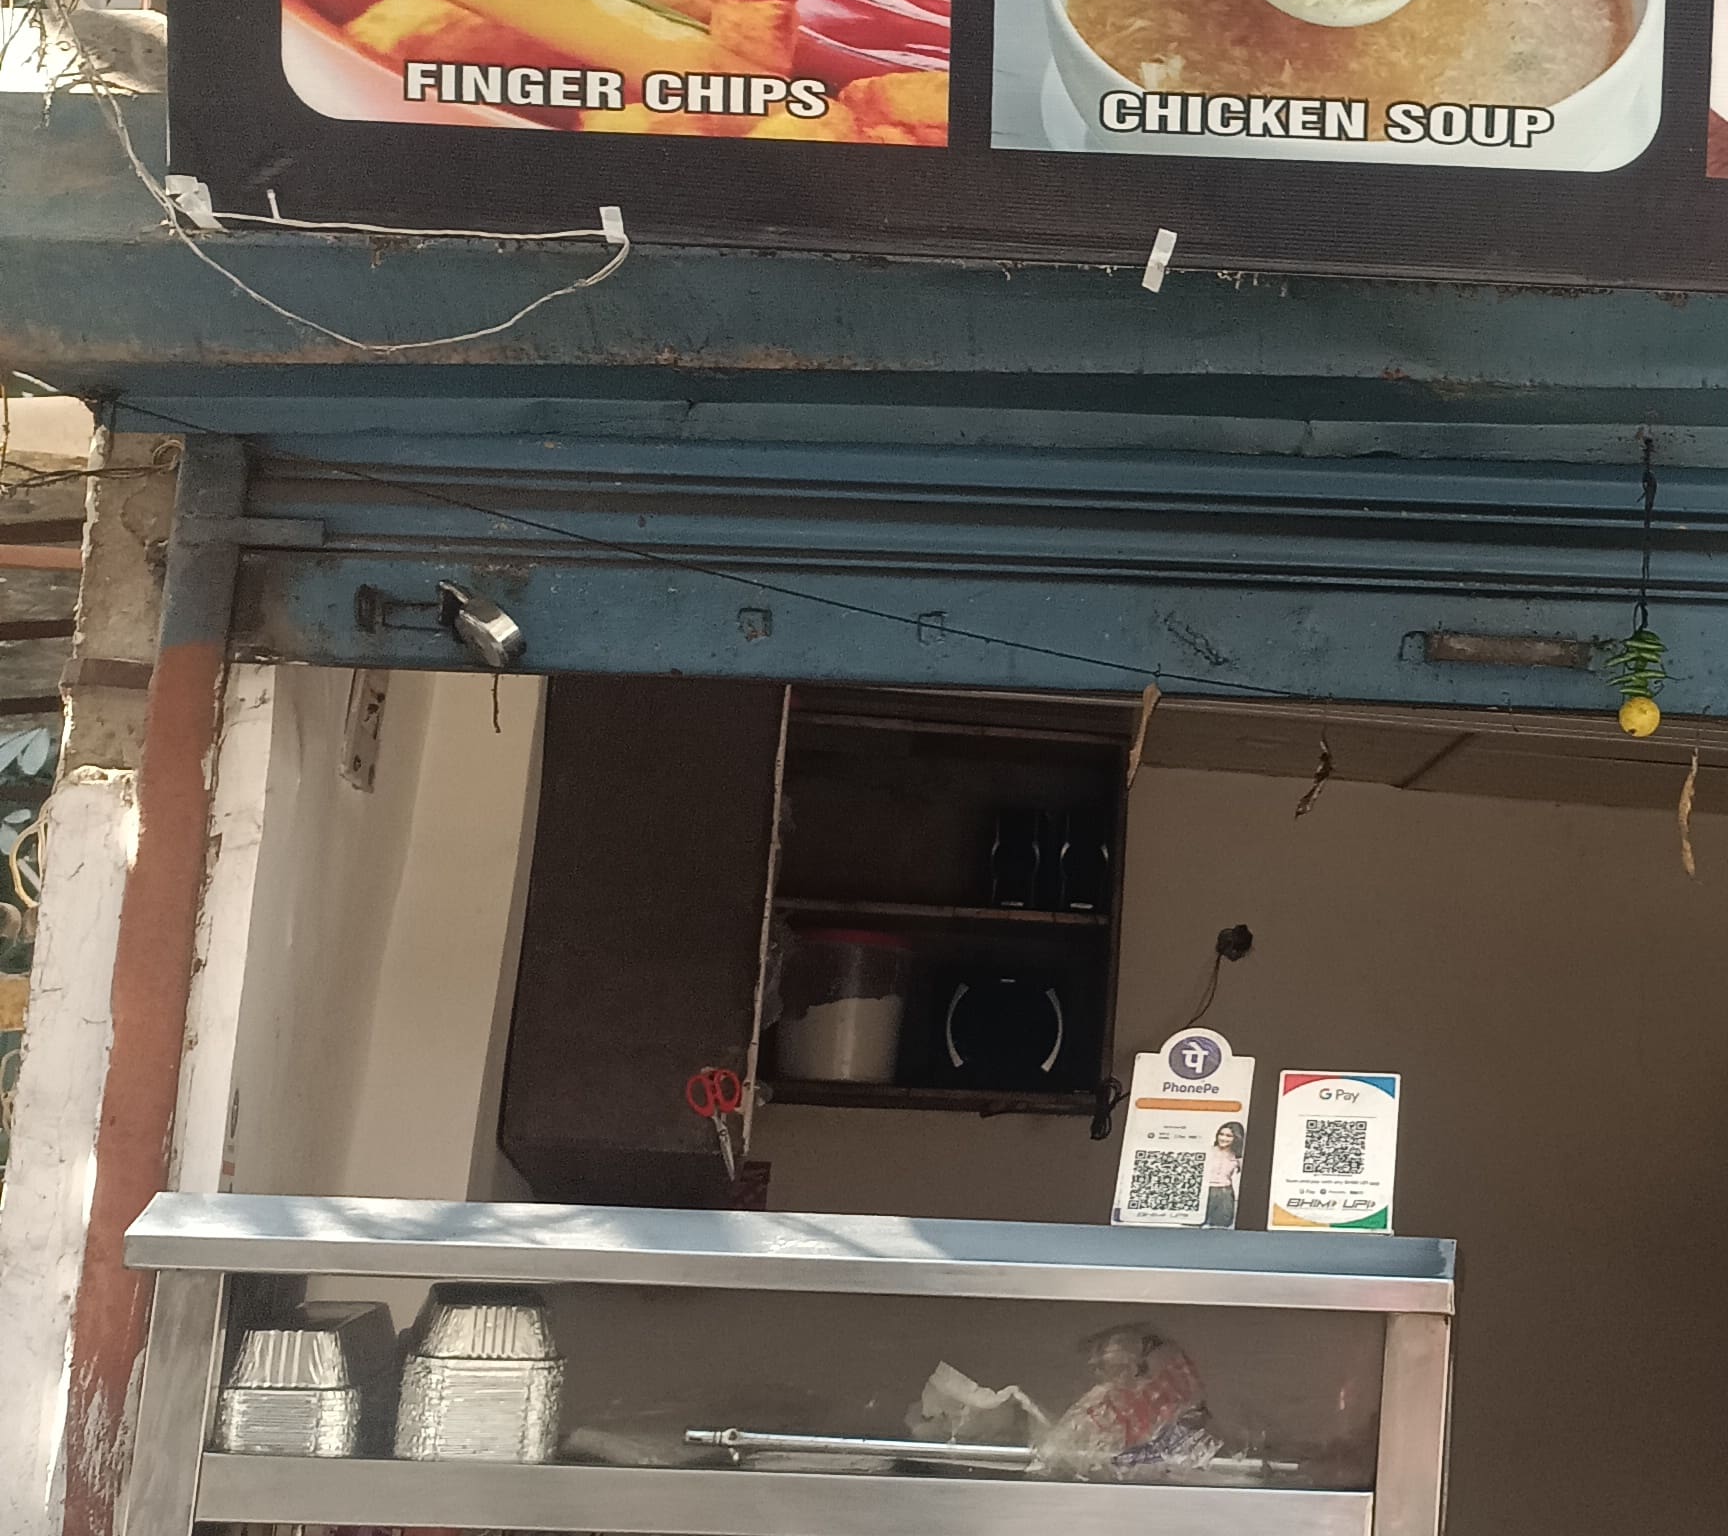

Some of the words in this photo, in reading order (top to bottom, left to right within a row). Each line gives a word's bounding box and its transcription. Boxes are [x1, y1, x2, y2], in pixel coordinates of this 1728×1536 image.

[404, 61, 624, 113] FINGER
[643, 68, 830, 120] CHIPS
[1100, 89, 1370, 141] CHICKEN
[1386, 98, 1555, 148] SOUP
[1162, 1081, 1220, 1094] PhonePe
[1335, 1089, 1359, 1104] Pay
